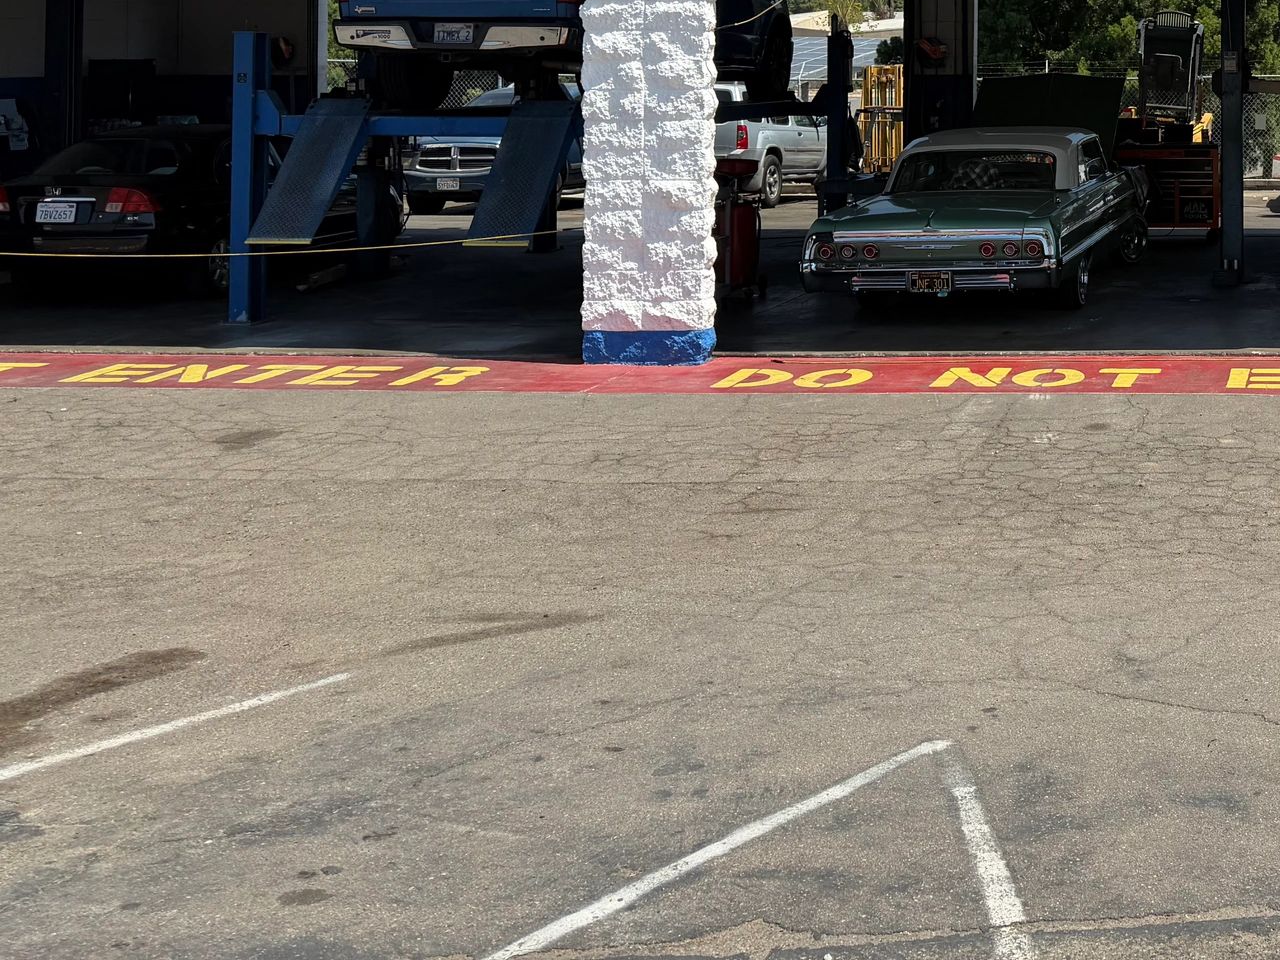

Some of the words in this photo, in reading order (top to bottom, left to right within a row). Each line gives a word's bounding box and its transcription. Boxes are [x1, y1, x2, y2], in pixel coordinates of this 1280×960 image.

[436, 30, 461, 41] TIMEX
[465, 30, 471, 41] 2
[39, 209, 73, 220] 7BVZ657
[933, 278, 948, 289] 301
[57, 363, 490, 387] ENTER
[711, 368, 874, 389] DO
[928, 367, 1162, 388] NOT
